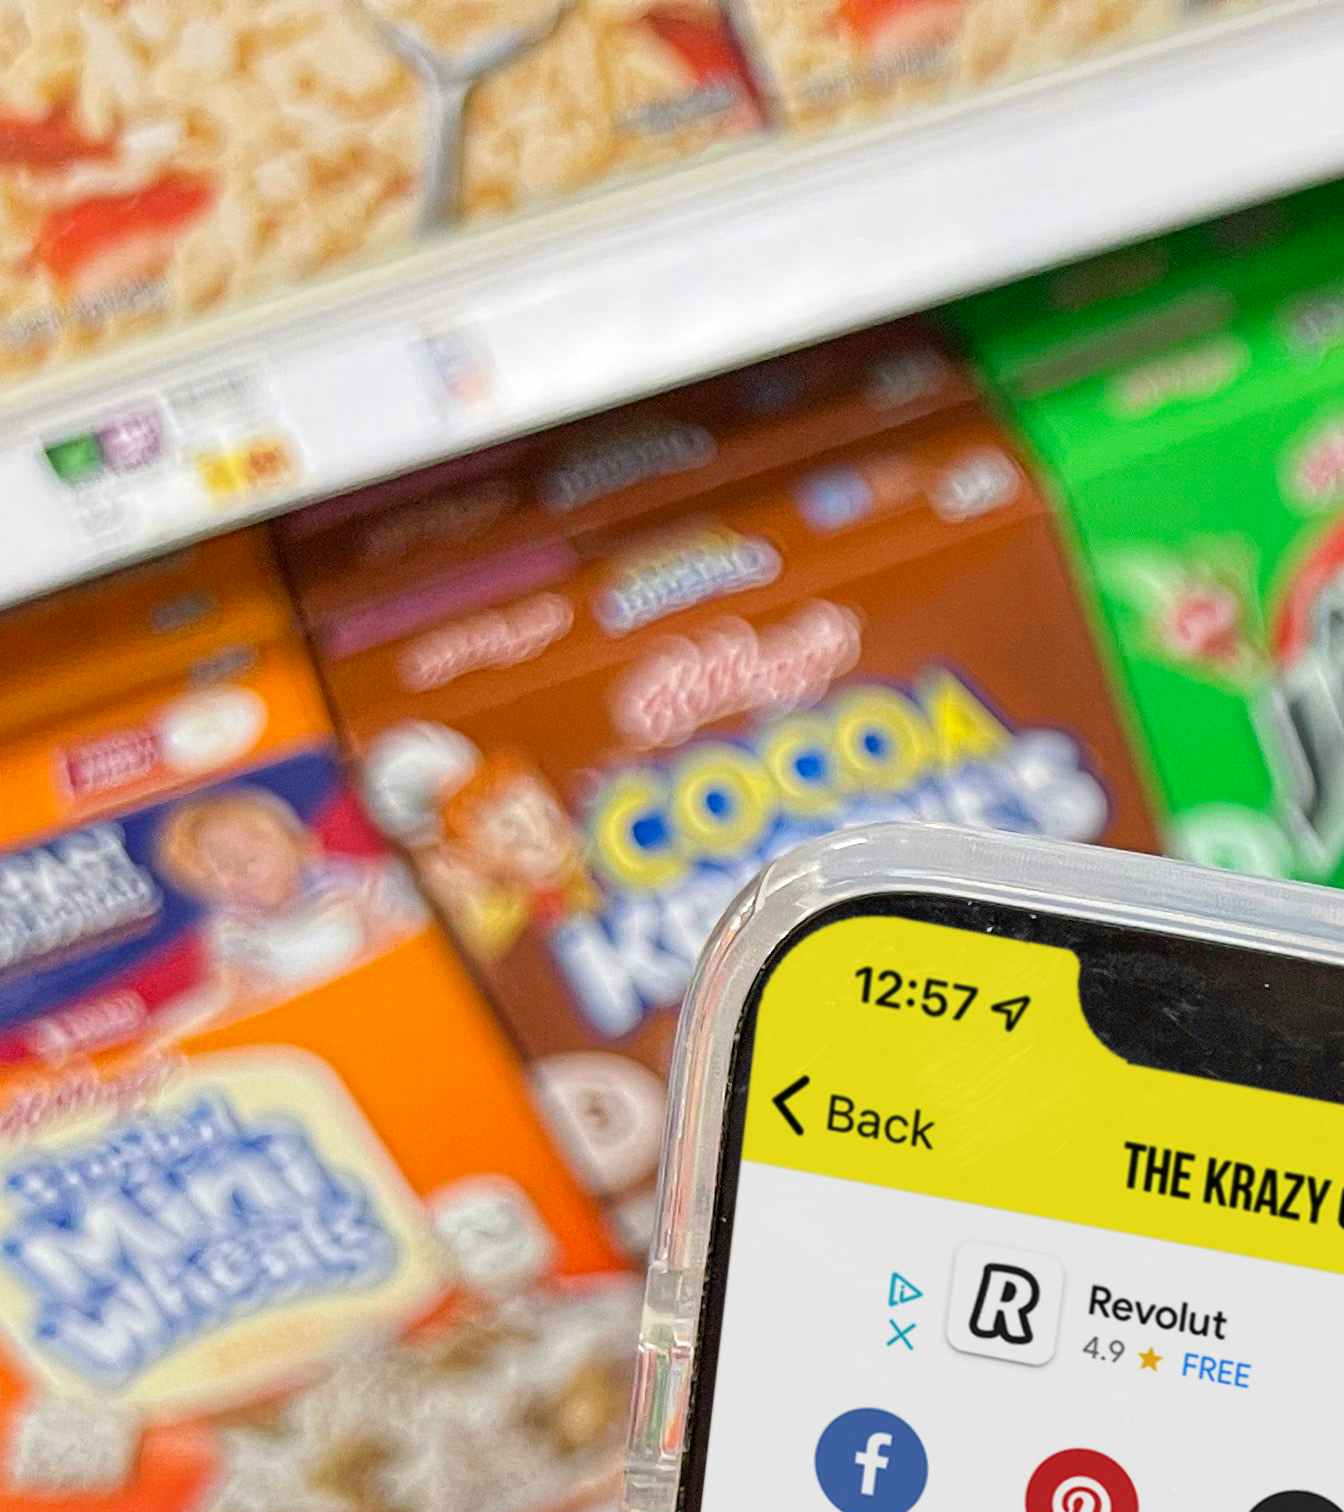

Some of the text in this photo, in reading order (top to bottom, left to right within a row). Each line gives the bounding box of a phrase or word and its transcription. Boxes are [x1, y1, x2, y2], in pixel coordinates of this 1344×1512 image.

[588, 667, 1014, 892] COCOA
[855, 966, 978, 1022] 12:57
[826, 1094, 935, 1150] Back
[1124, 1141, 1197, 1199] THE
[1203, 1156, 1332, 1226] KRAZY
[1088, 1285, 1228, 1341] Revolut
[1082, 1336, 1253, 1389] 4.9 FREE
